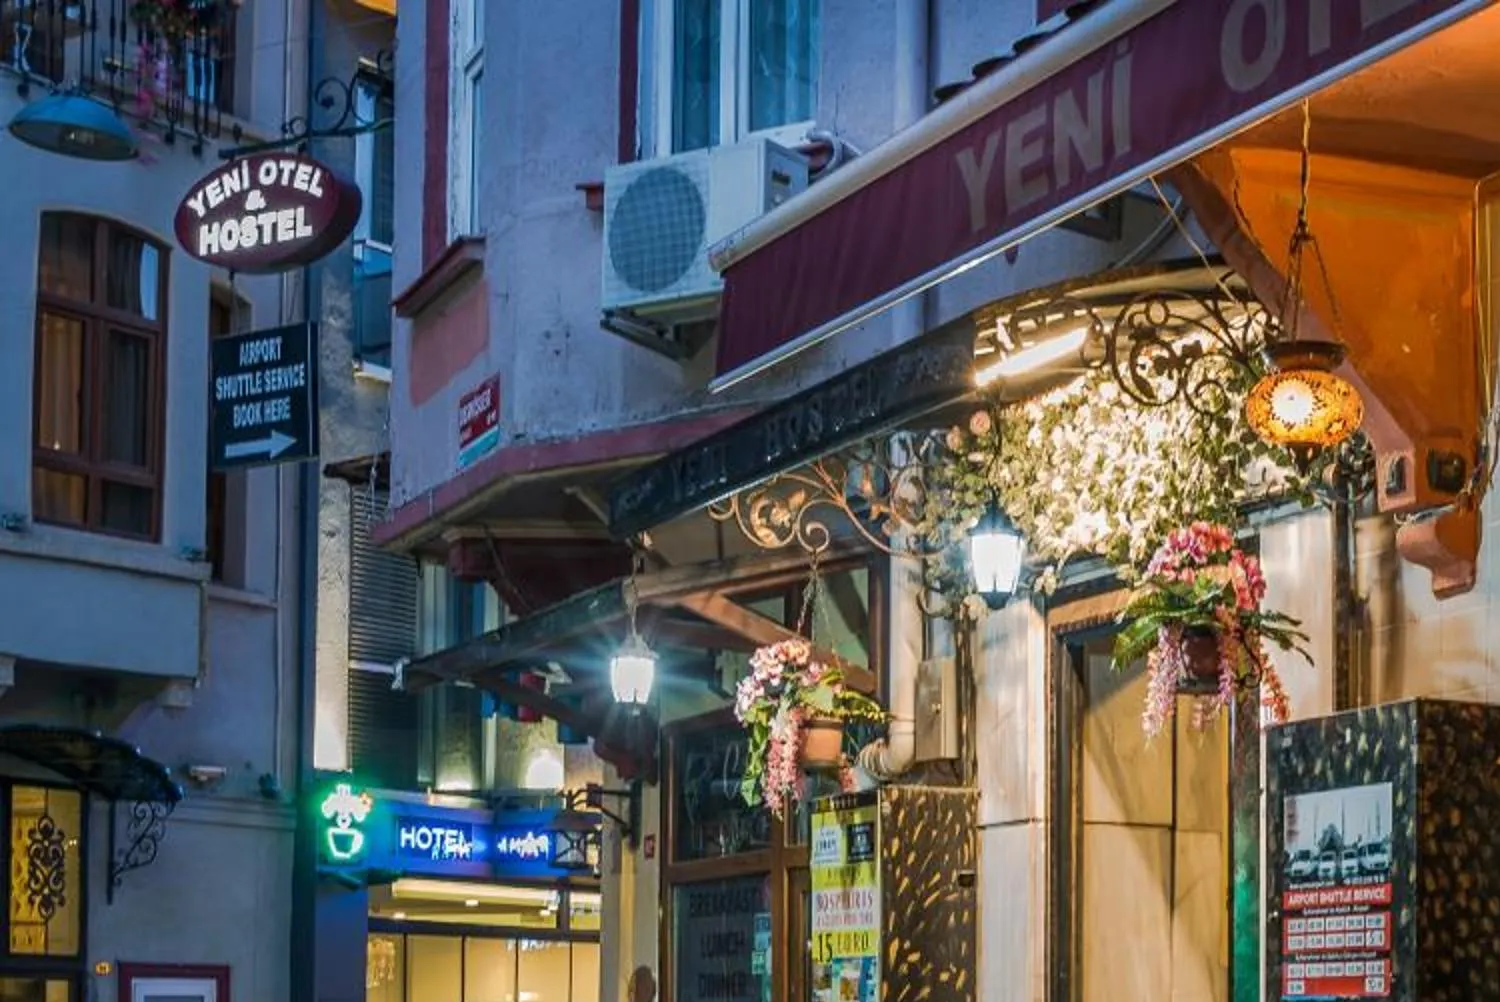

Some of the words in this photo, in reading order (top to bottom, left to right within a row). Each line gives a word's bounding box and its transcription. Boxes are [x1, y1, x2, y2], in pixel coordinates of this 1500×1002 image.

[259, 160, 324, 198] OTEL
[245, 189, 267, 211] &
[199, 205, 313, 257] HOSTEL
[240, 336, 282, 367] AIRPORT
[215, 371, 262, 400] SHUTTLE
[264, 361, 305, 392] SERVICE
[233, 402, 263, 429] BOOK
[263, 396, 291, 422] HERE
[817, 932, 833, 964] 15
